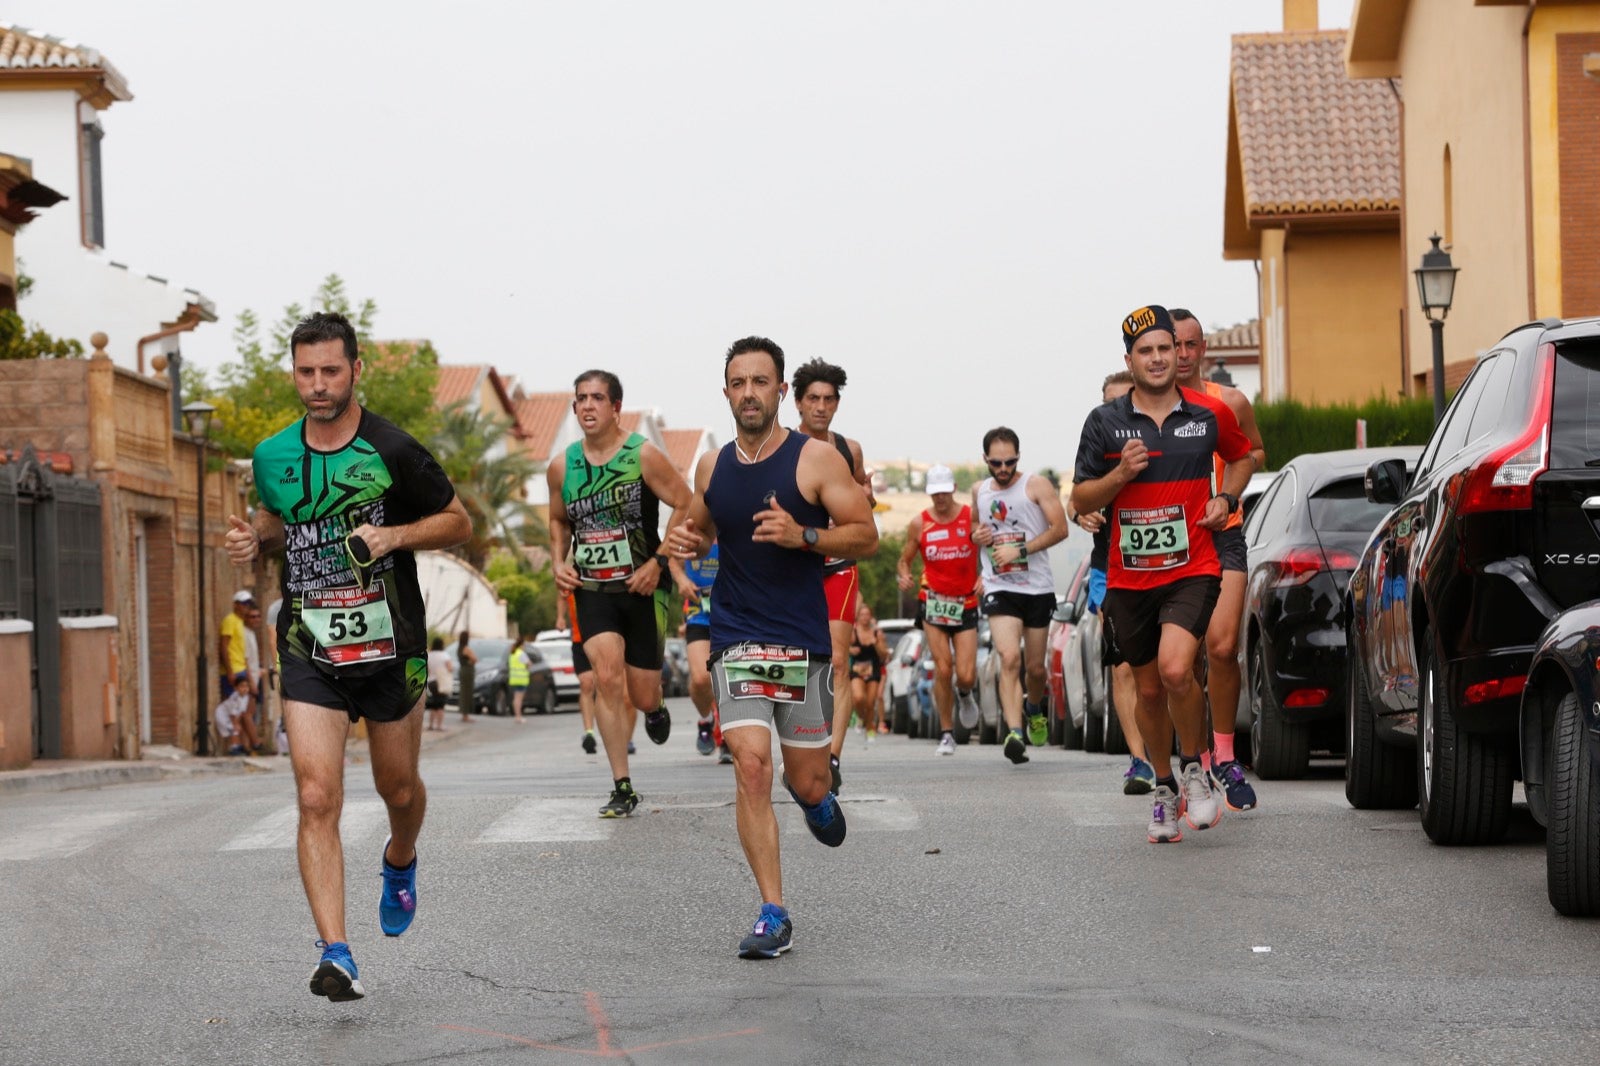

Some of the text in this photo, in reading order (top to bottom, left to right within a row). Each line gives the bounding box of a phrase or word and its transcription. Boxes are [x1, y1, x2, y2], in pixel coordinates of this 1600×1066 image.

[1130, 525, 1177, 550] 923
[584, 545, 620, 565] 221
[335, 588, 355, 599] PREMIO
[935, 602, 957, 616] 618
[328, 611, 368, 641] 53
